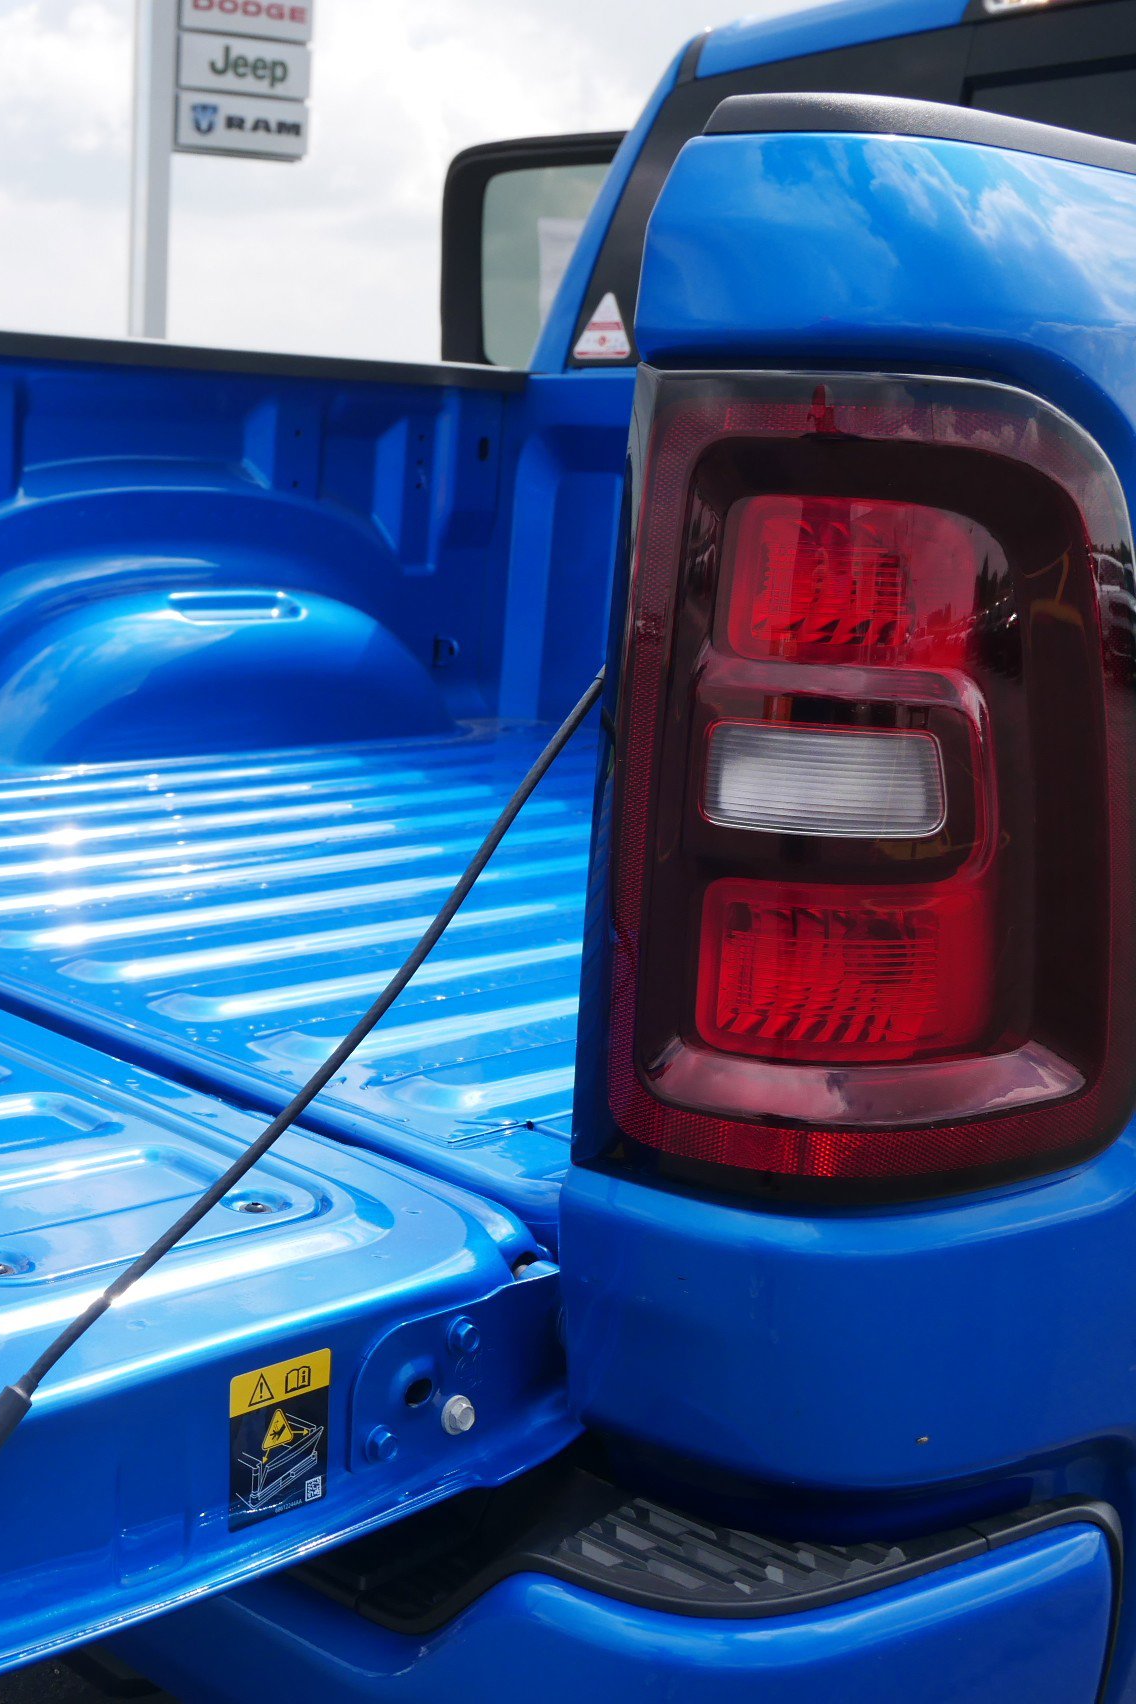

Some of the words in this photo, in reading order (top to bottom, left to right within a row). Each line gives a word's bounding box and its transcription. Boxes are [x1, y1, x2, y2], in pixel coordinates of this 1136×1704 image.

[192, 0, 307, 24] DODGE
[209, 44, 288, 88] Jeep
[224, 115, 301, 137] RAM
